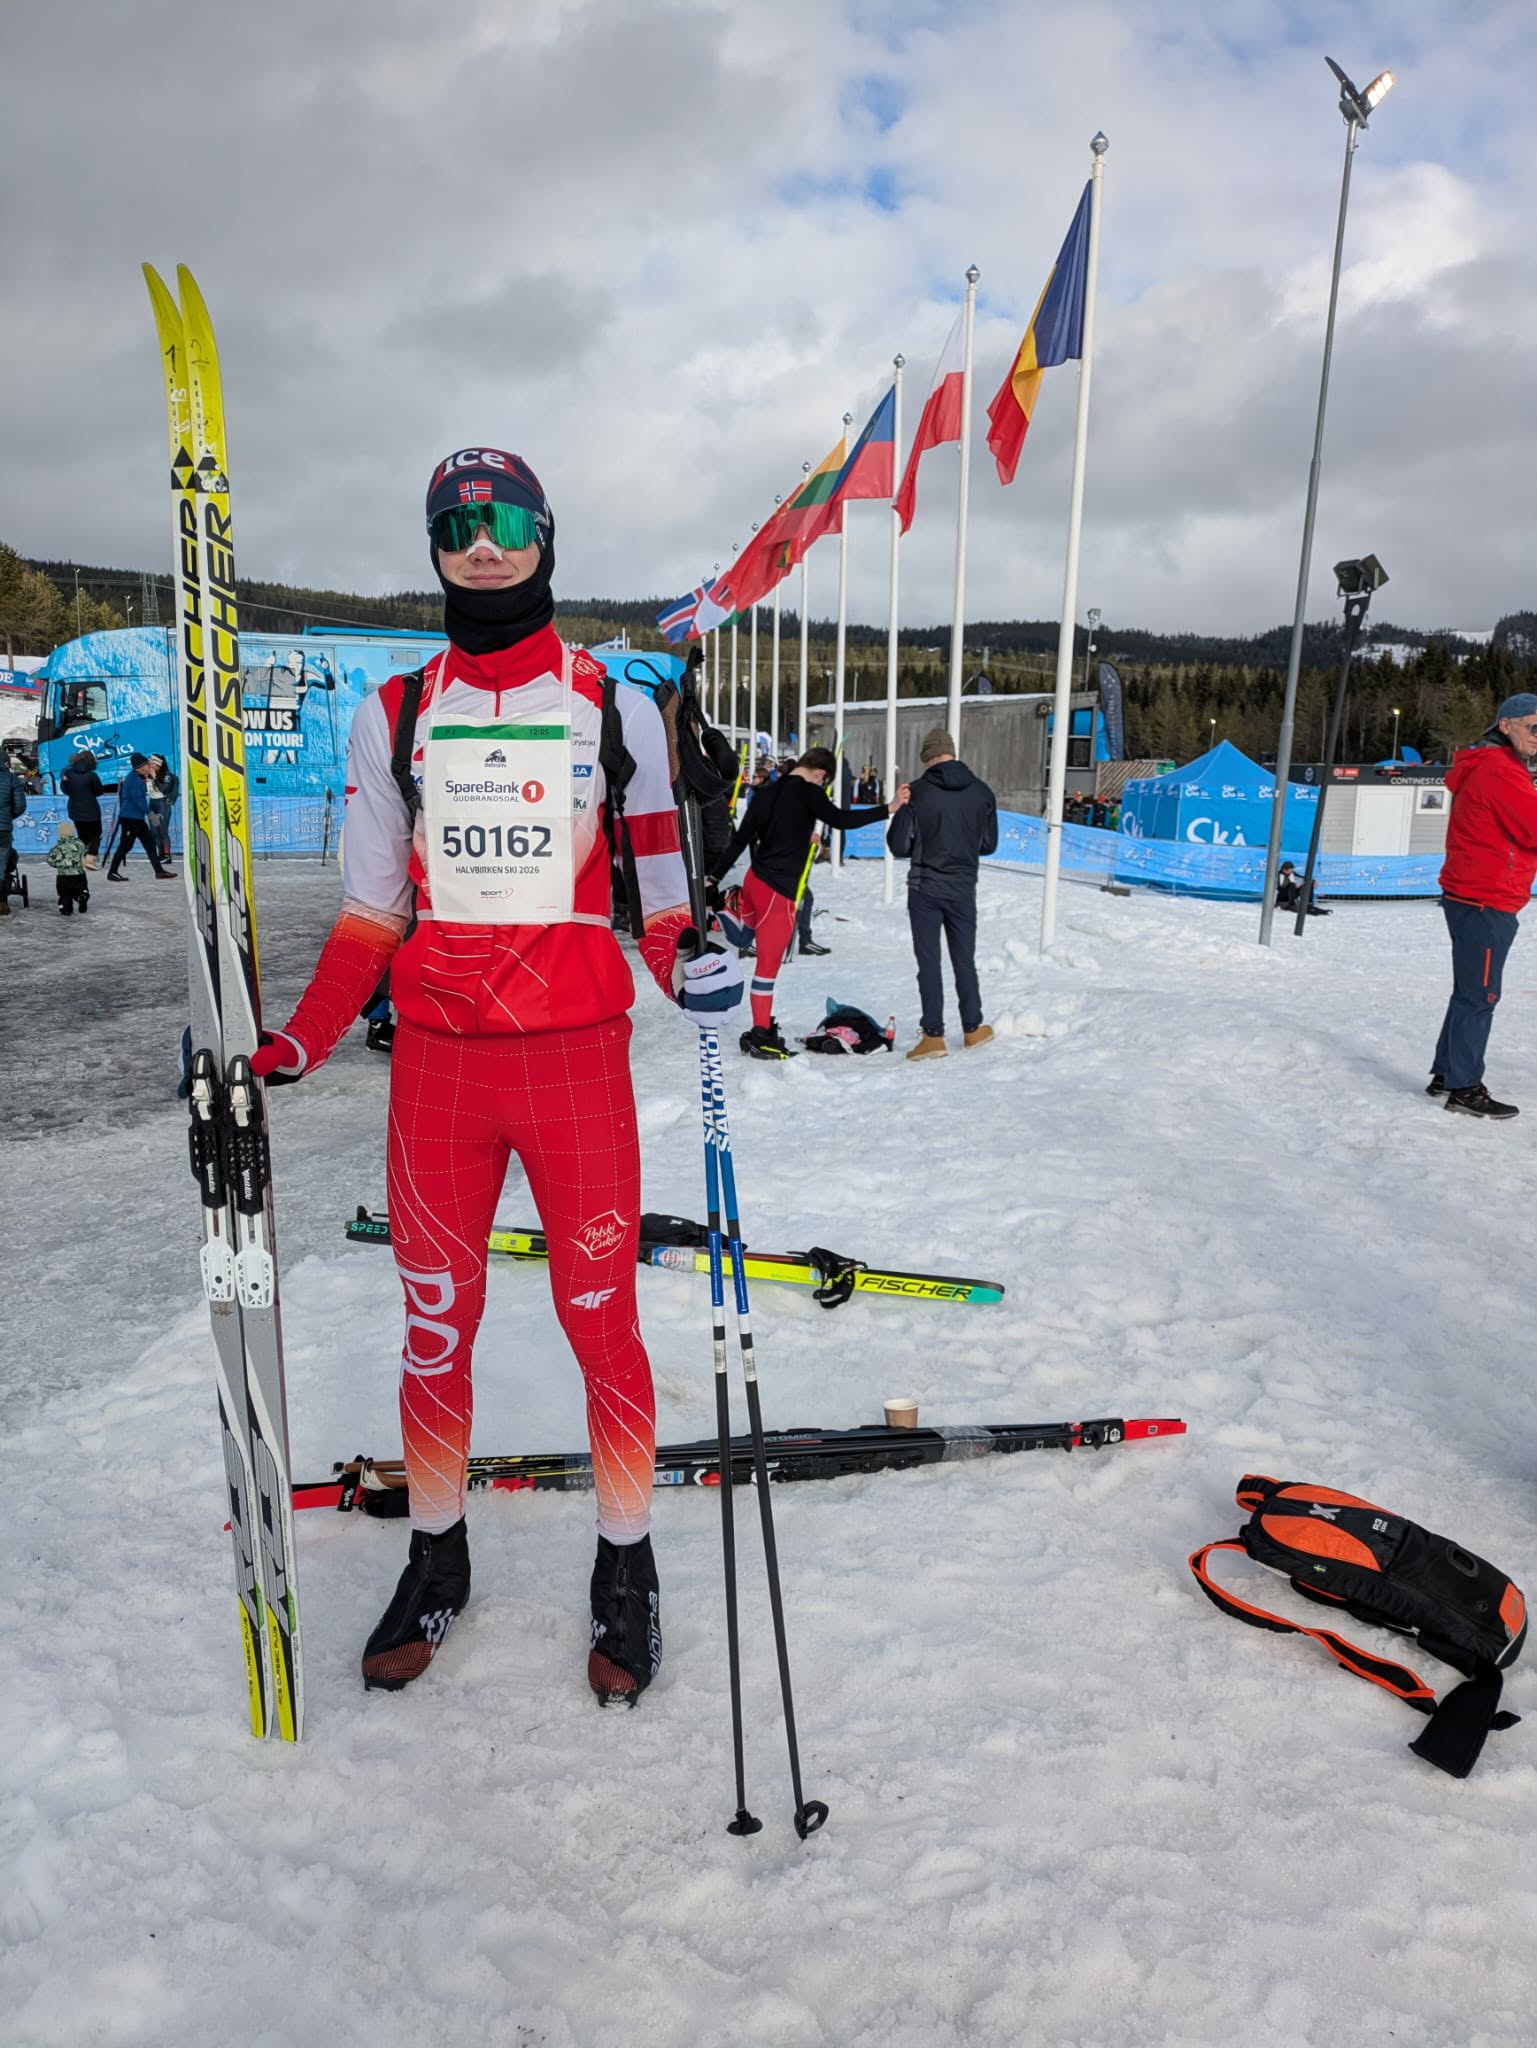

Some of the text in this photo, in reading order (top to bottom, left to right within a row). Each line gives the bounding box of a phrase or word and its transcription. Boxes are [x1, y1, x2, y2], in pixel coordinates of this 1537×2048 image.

[180, 498, 210, 769] FISCHER
[204, 502, 244, 776] FISCHER
[269, 710, 293, 730] US
[245, 733, 304, 747] ON TOUR!
[445, 780, 519, 795] SpareBank
[443, 825, 553, 858] 50162
[1186, 817, 1247, 847] Ski
[455, 866, 540, 874] HALVBIRKEN SKI 2026
[584, 1222, 617, 1242] Polski
[589, 1231, 625, 1252] Cukier
[570, 1287, 617, 1309] 4F
[860, 1278, 973, 1300] FISCHER
